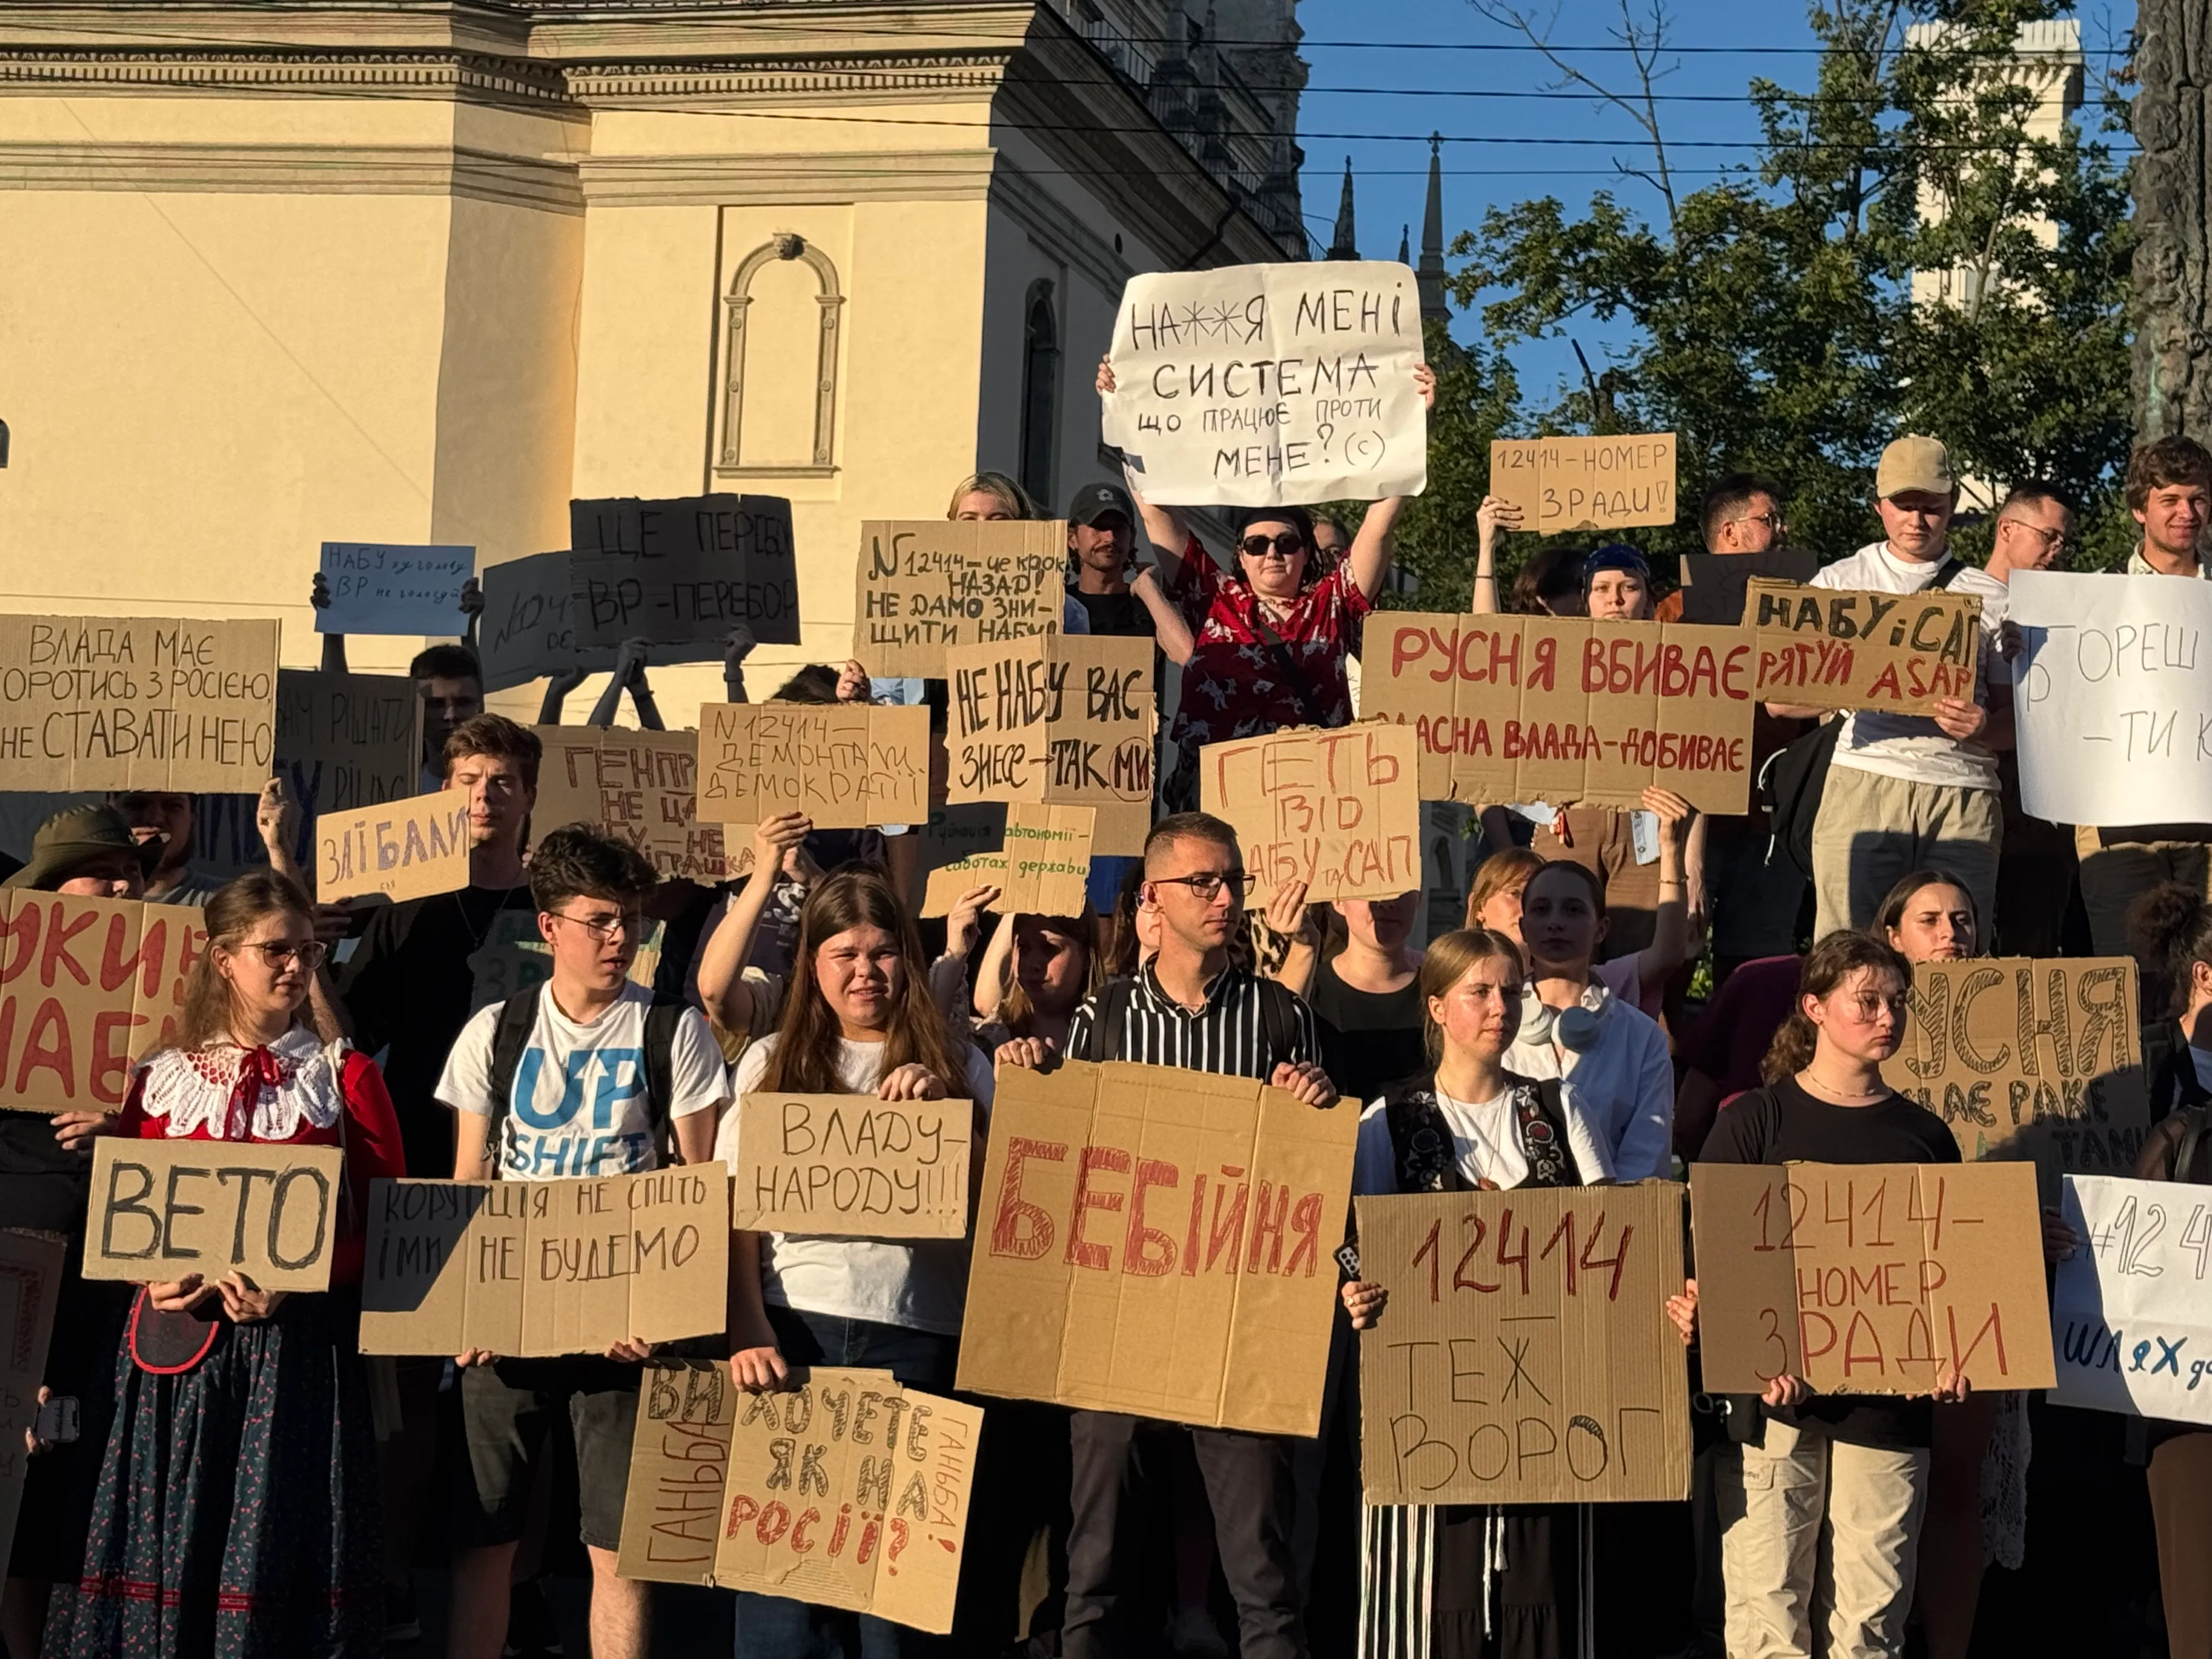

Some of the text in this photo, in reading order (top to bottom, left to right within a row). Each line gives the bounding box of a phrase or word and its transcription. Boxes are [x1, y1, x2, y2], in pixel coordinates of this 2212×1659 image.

[1153, 352, 1379, 400] СИСТЕМА
[1138, 398, 1382, 436] ЩО ПРАЦЮЄ ПРОТИ
[1497, 449, 1559, 469] 12414
[1584, 444, 1667, 471] НОМЕР
[329, 546, 386, 570] НАБУ
[597, 510, 667, 562] ЦЕ
[336, 575, 369, 598] ВР
[948, 569, 1045, 597] НАЗАД!
[987, 557, 1011, 573] це
[1016, 553, 1065, 576] крок
[588, 578, 642, 630] ВР
[866, 590, 900, 618] НЕ
[910, 594, 984, 619] ДАМО
[1756, 593, 1899, 640] НАБУ
[30, 625, 214, 667] ВЛАДА МАЄ
[870, 620, 958, 648] ЩИТИ
[0, 667, 272, 706] ОРОТИСЬ З РОСІЄЮ,
[1391, 626, 1751, 700] РУСНЯ ВБИВАЄ
[1756, 639, 1972, 700] РЯТУЙ ASAP
[956, 659, 1143, 739] НЕ НАБУ ВАС
[1, 708, 272, 767] НЕ СТАВАТИ НЕЮ
[716, 742, 916, 774] ДЕМОНТАЖ
[1375, 712, 1493, 758] АСНА
[2120, 710, 2178, 763] ТИ
[565, 746, 698, 789] ГЕНПР
[1052, 739, 1110, 791] ТАК
[1114, 744, 1150, 791] МИ
[1217, 732, 1400, 809] ГЕТЬ
[601, 789, 643, 821] НЕ
[1280, 794, 1364, 837] ВІД
[687, 828, 724, 857] НЕ
[1249, 837, 1321, 888] АБУ
[1344, 835, 1412, 888] САП
[1905, 966, 2131, 1080] УСНЯ
[515, 1047, 648, 1130] UP
[509, 1132, 646, 1176] SHIFT
[384, 1175, 707, 1223] КОРУПЦІЯ НЕ СПИТЬ
[756, 1161, 960, 1215] НАРОДУ!!!
[989, 1136, 1325, 1279] БЕБІЙНЯ
[101, 1158, 330, 1271] ВЕТО
[479, 1235, 520, 1283] НЕ
[540, 1224, 701, 1282] БУДЕМО
[1412, 1209, 1635, 1302] 12414
[1797, 1260, 1947, 1308] НОМЕР
[1386, 1336, 1551, 1411] ТЕЖ
[2063, 1322, 2188, 1376] ШЛЯХ
[647, 1365, 933, 1462] ВИ ХОЧЕТЕ
[1389, 1407, 1661, 1494] ВОРОГ
[646, 1420, 731, 1563] ГАНЬБА
[766, 1438, 929, 1521] ЯК НА
[726, 1494, 910, 1577] РОСІЇ?
